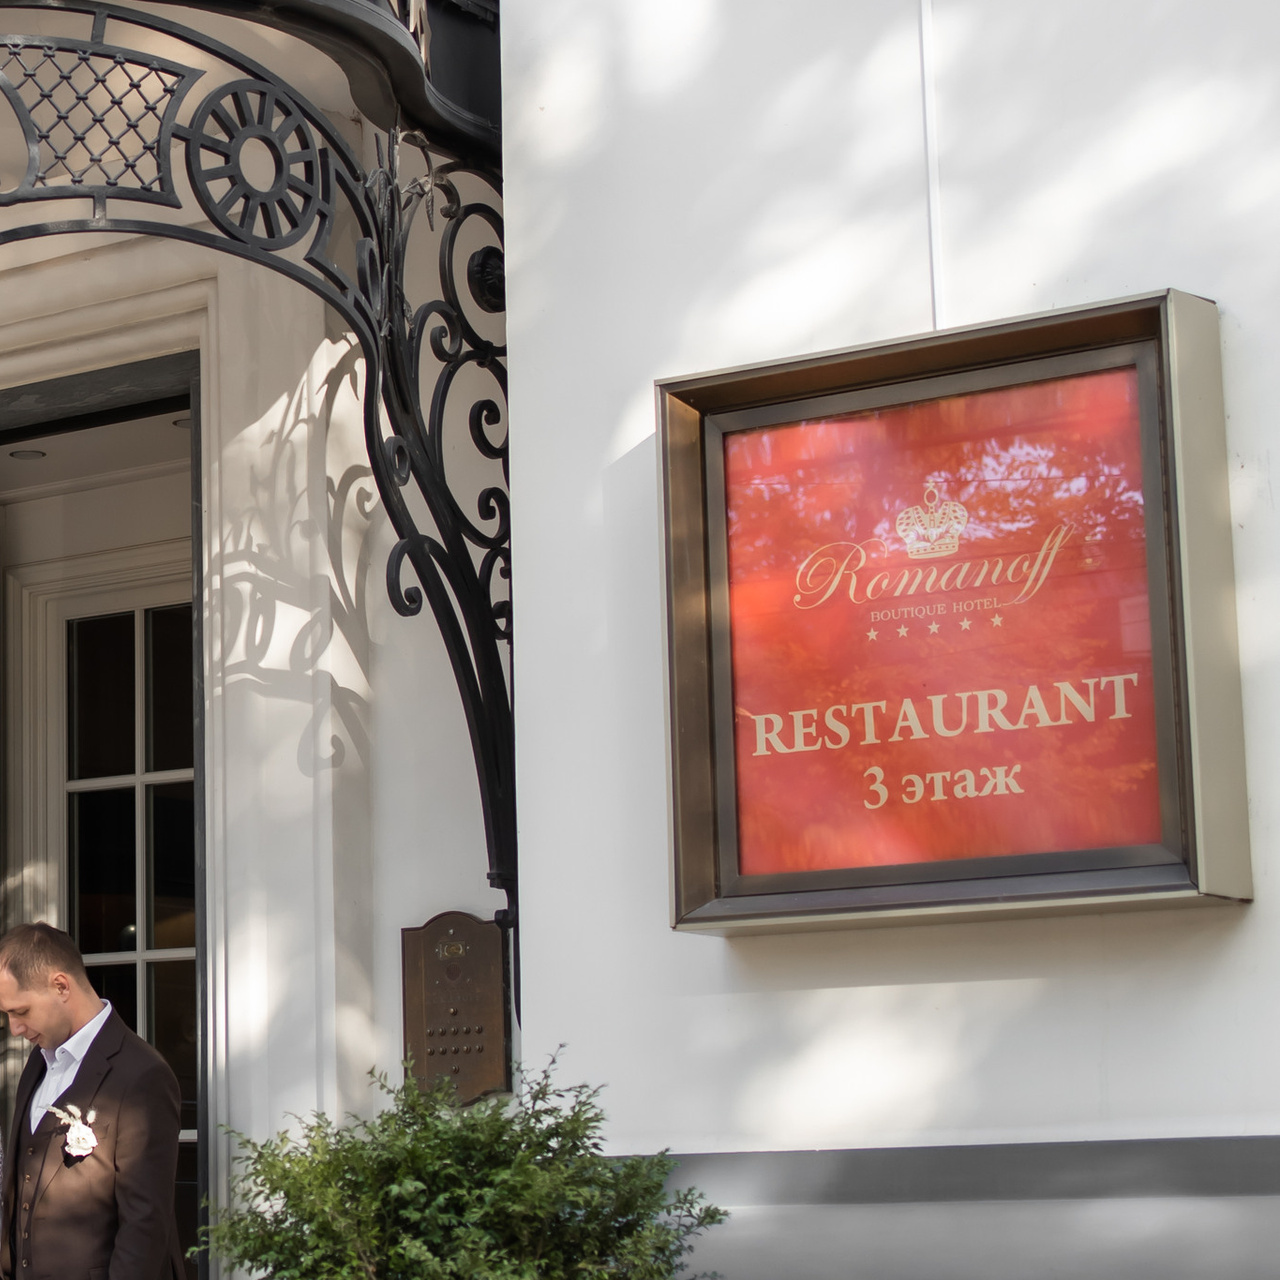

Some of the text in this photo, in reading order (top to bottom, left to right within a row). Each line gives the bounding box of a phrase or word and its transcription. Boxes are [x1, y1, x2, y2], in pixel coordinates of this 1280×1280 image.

[792, 523, 1075, 609] Romanoff
[870, 597, 1003, 622] BOUTIQUE HOTEL
[751, 672, 1139, 757] RESTAURANT
[862, 763, 1025, 810] 3 этаж
